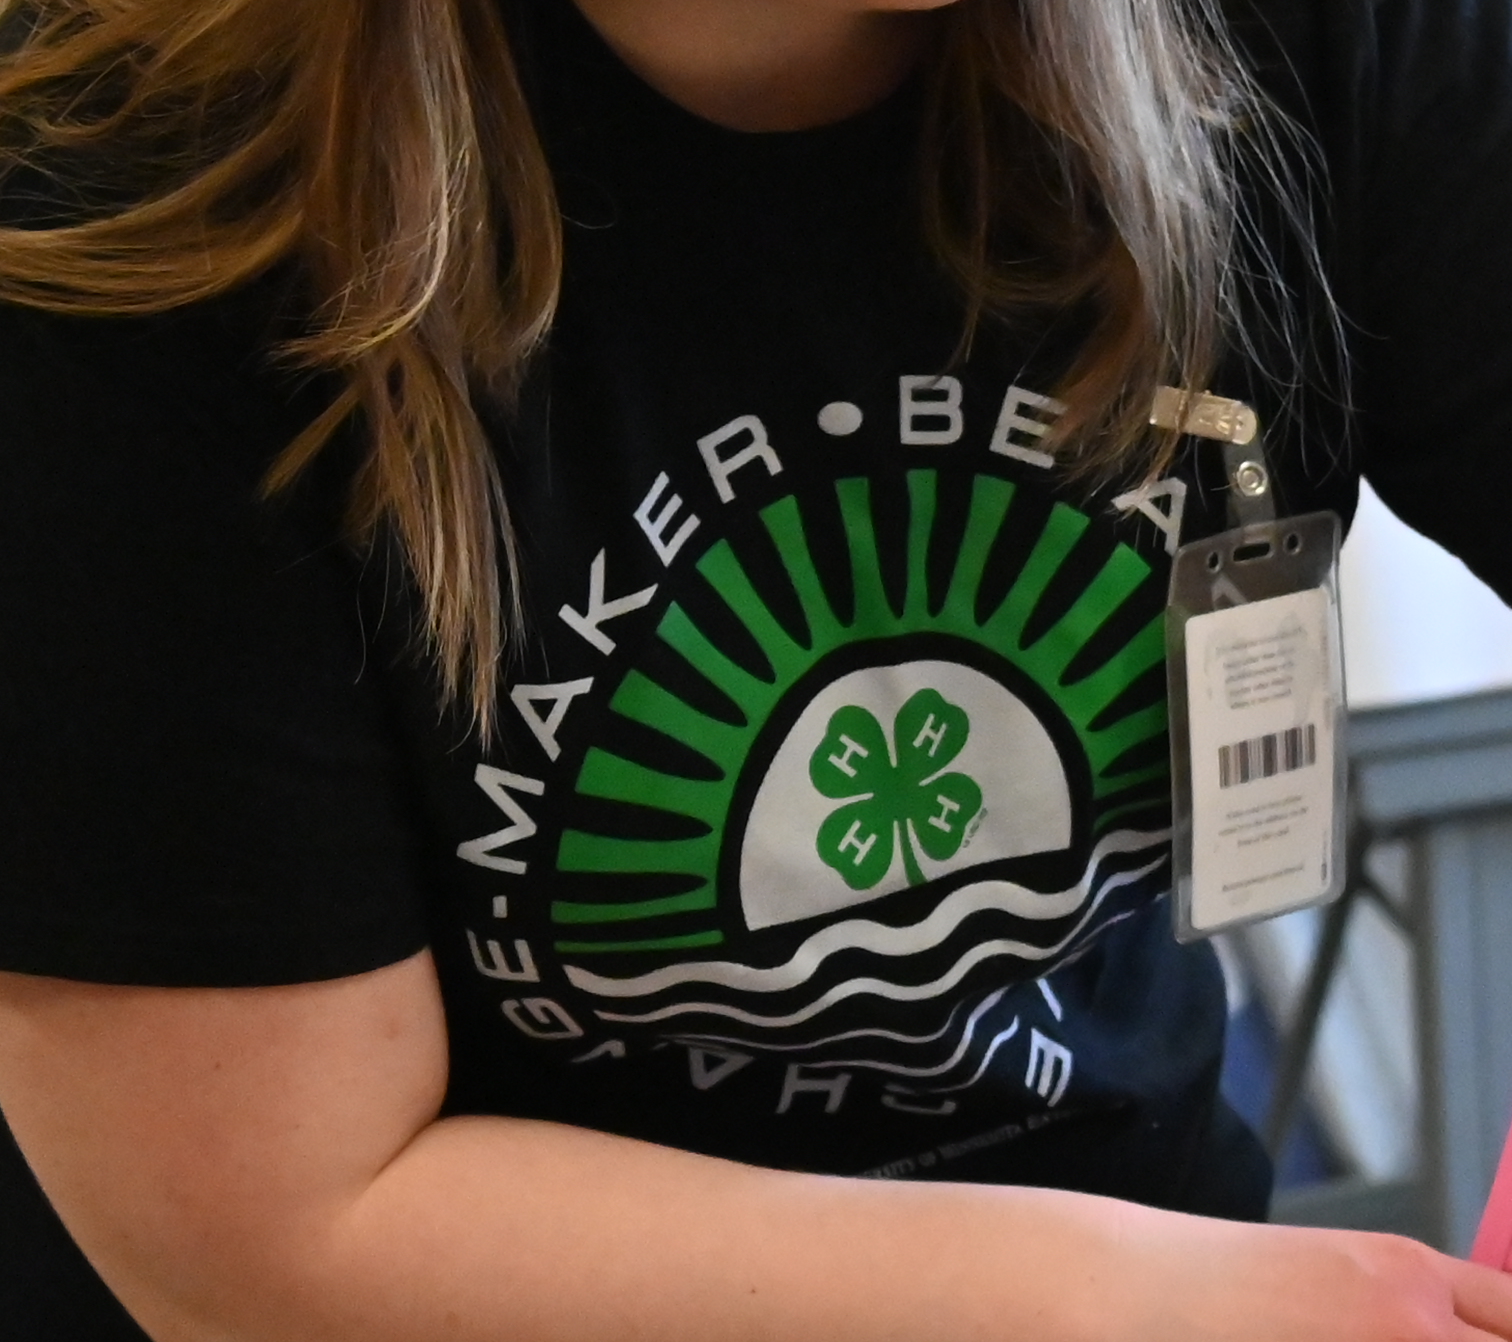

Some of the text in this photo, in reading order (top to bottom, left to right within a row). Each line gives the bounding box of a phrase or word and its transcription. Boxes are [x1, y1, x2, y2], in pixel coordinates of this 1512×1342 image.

[827, 733, 869, 778] H
[912, 713, 947, 758] H
[928, 794, 960, 833] H
[838, 819, 878, 866] H
